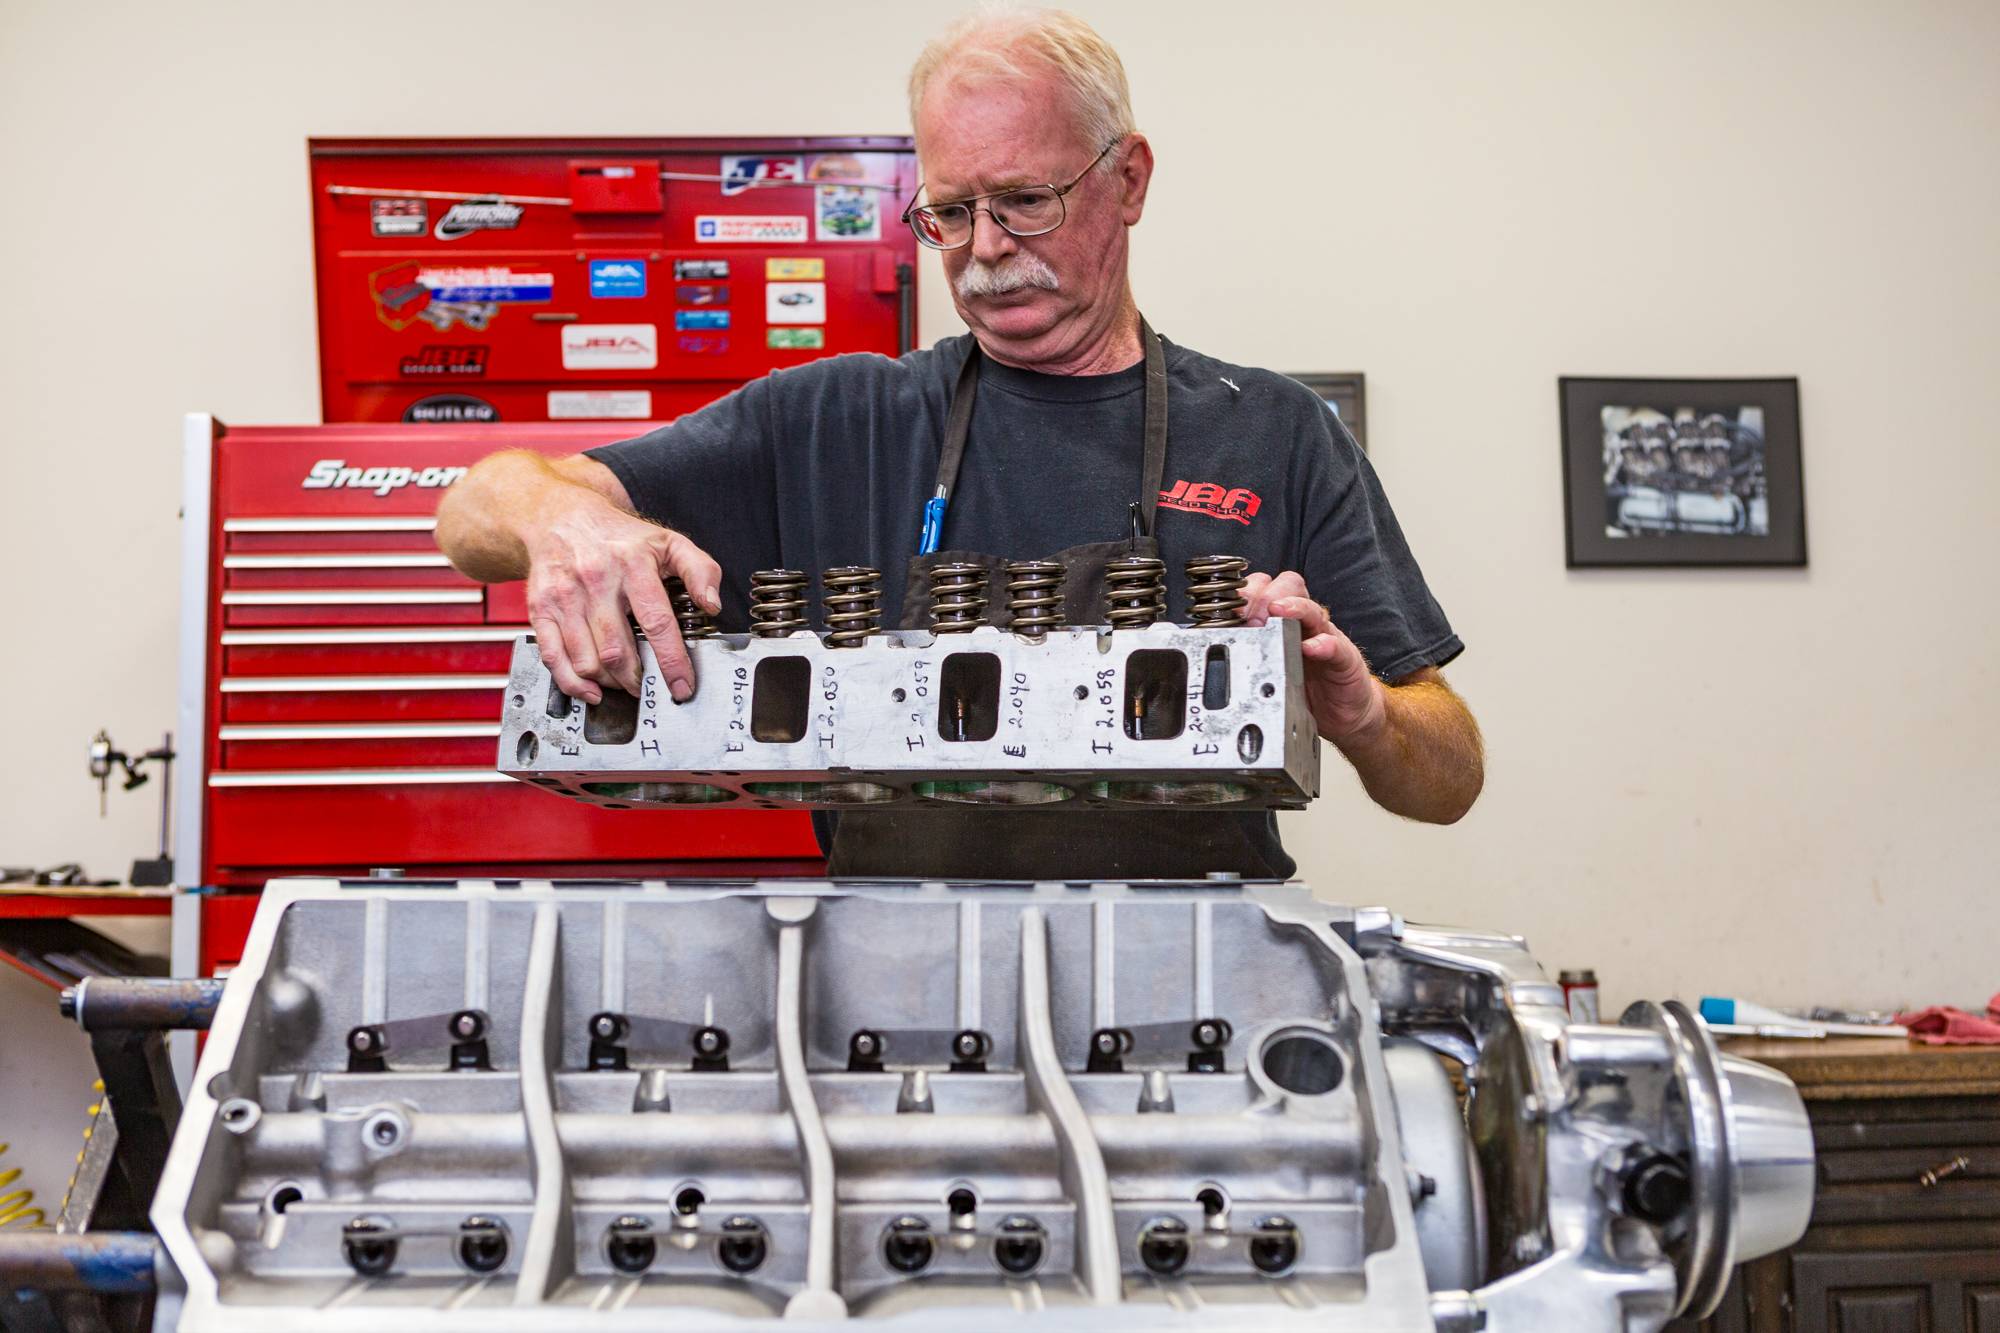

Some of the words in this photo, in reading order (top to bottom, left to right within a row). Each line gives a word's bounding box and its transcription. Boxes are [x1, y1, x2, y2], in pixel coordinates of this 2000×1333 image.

[1159, 480, 1262, 517] JBA
[1206, 503, 1250, 518] SHOP
[643, 675, 658, 729] 2.050
[1008, 672, 1031, 729] 2.040
[1096, 668, 1116, 728] 2.058
